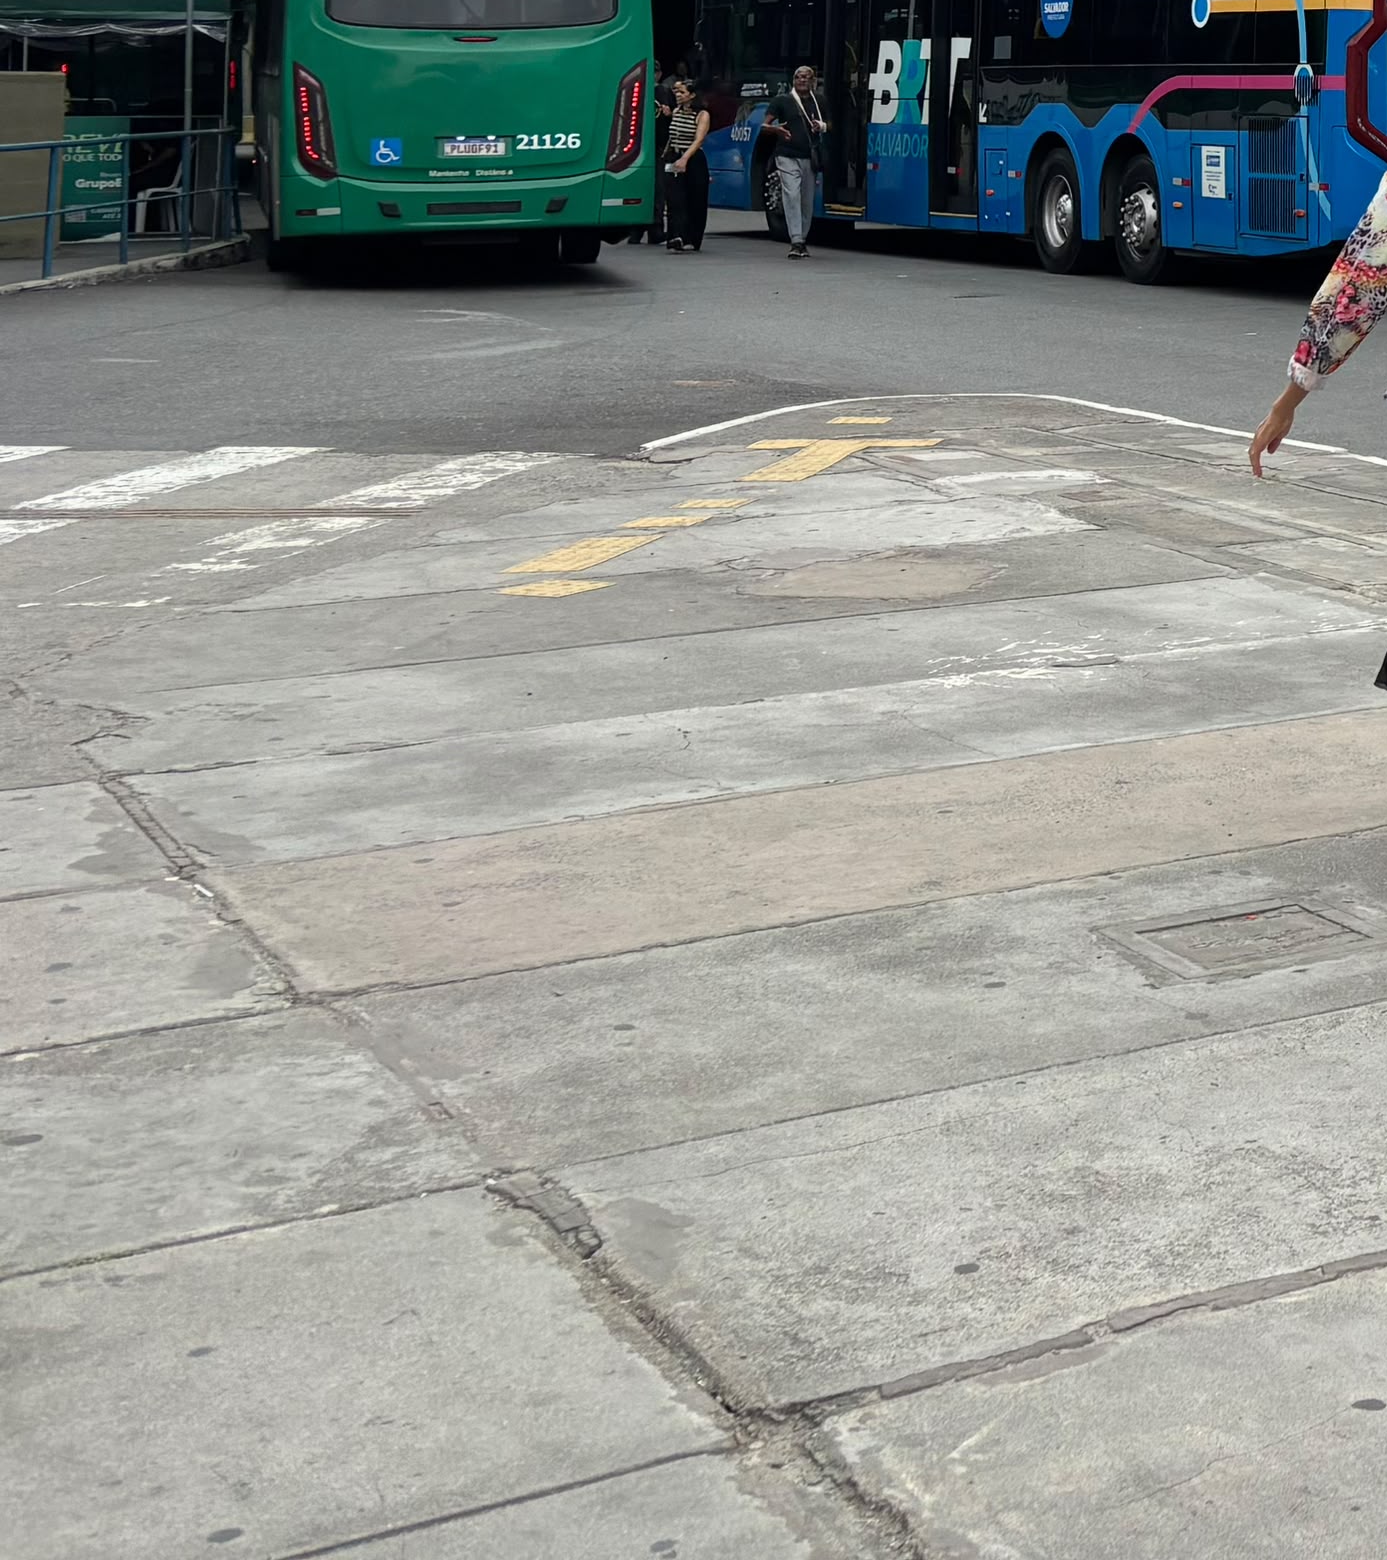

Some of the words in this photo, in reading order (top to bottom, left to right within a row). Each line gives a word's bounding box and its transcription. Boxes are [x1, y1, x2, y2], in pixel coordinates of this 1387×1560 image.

[1044, 1, 1069, 14] SALVADOR
[515, 133, 581, 150] 21126
[867, 132, 928, 158] SALVADOR
